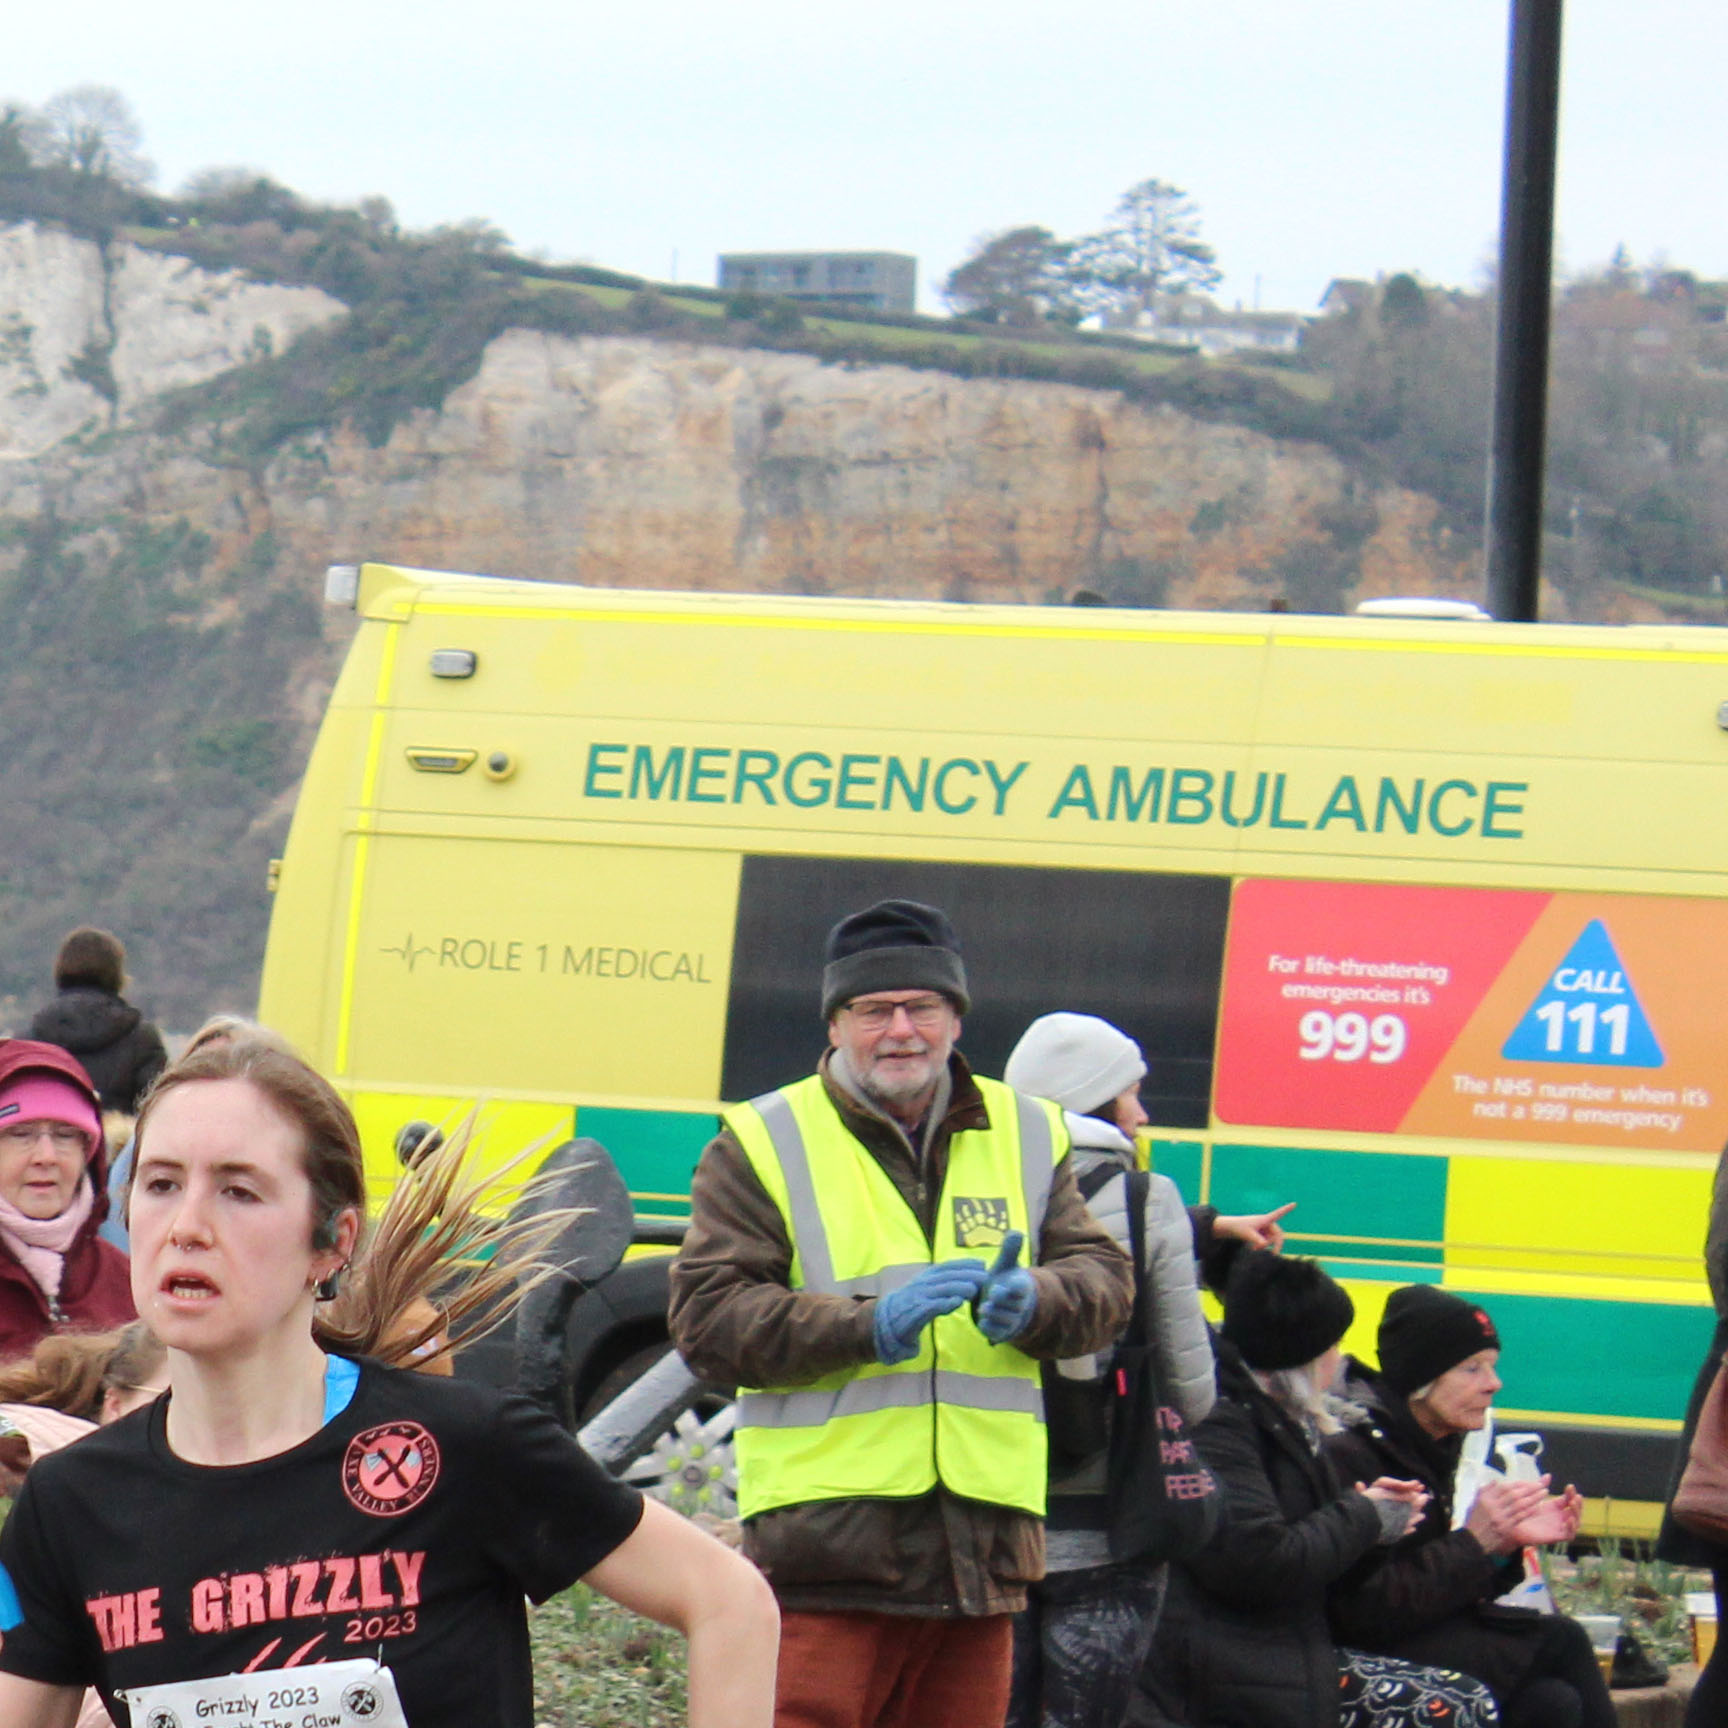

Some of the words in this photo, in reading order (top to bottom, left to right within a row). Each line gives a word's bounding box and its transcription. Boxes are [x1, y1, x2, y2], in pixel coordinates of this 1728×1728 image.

[582, 743, 1029, 815] EMERGENCY
[1047, 764, 1530, 840] AMBULANCE
[439, 937, 524, 972] ROLE
[537, 944, 548, 973] 1
[561, 945, 712, 984] MEDICAL
[1268, 954, 1299, 974] For
[1305, 955, 1449, 985] life-threatening
[1281, 981, 1400, 1004] emergencies
[1403, 984, 1431, 1005] it's
[1553, 968, 1625, 994] CALL
[1298, 1010, 1408, 1063] 999
[1535, 1000, 1630, 1055] 111
[1453, 1074, 1488, 1094] The
[1494, 1076, 1533, 1097] NHS
[1540, 1081, 1614, 1101] number
[1621, 1085, 1676, 1105] when
[1682, 1086, 1708, 1106] it's
[1473, 1099, 1507, 1119] not
[1513, 1106, 1526, 1120] a
[1531, 1103, 1567, 1122] 999
[1572, 1107, 1683, 1130] emergency
[352, 1482, 399, 1512] VALLEY
[86, 1587, 164, 1652] THE
[190, 1550, 426, 1634] GRIZZLY
[344, 1611, 417, 1643] 2023
[195, 1694, 259, 1718] Grizzly
[269, 1686, 320, 1710] 2023
[302, 1713, 342, 1728] Claw
